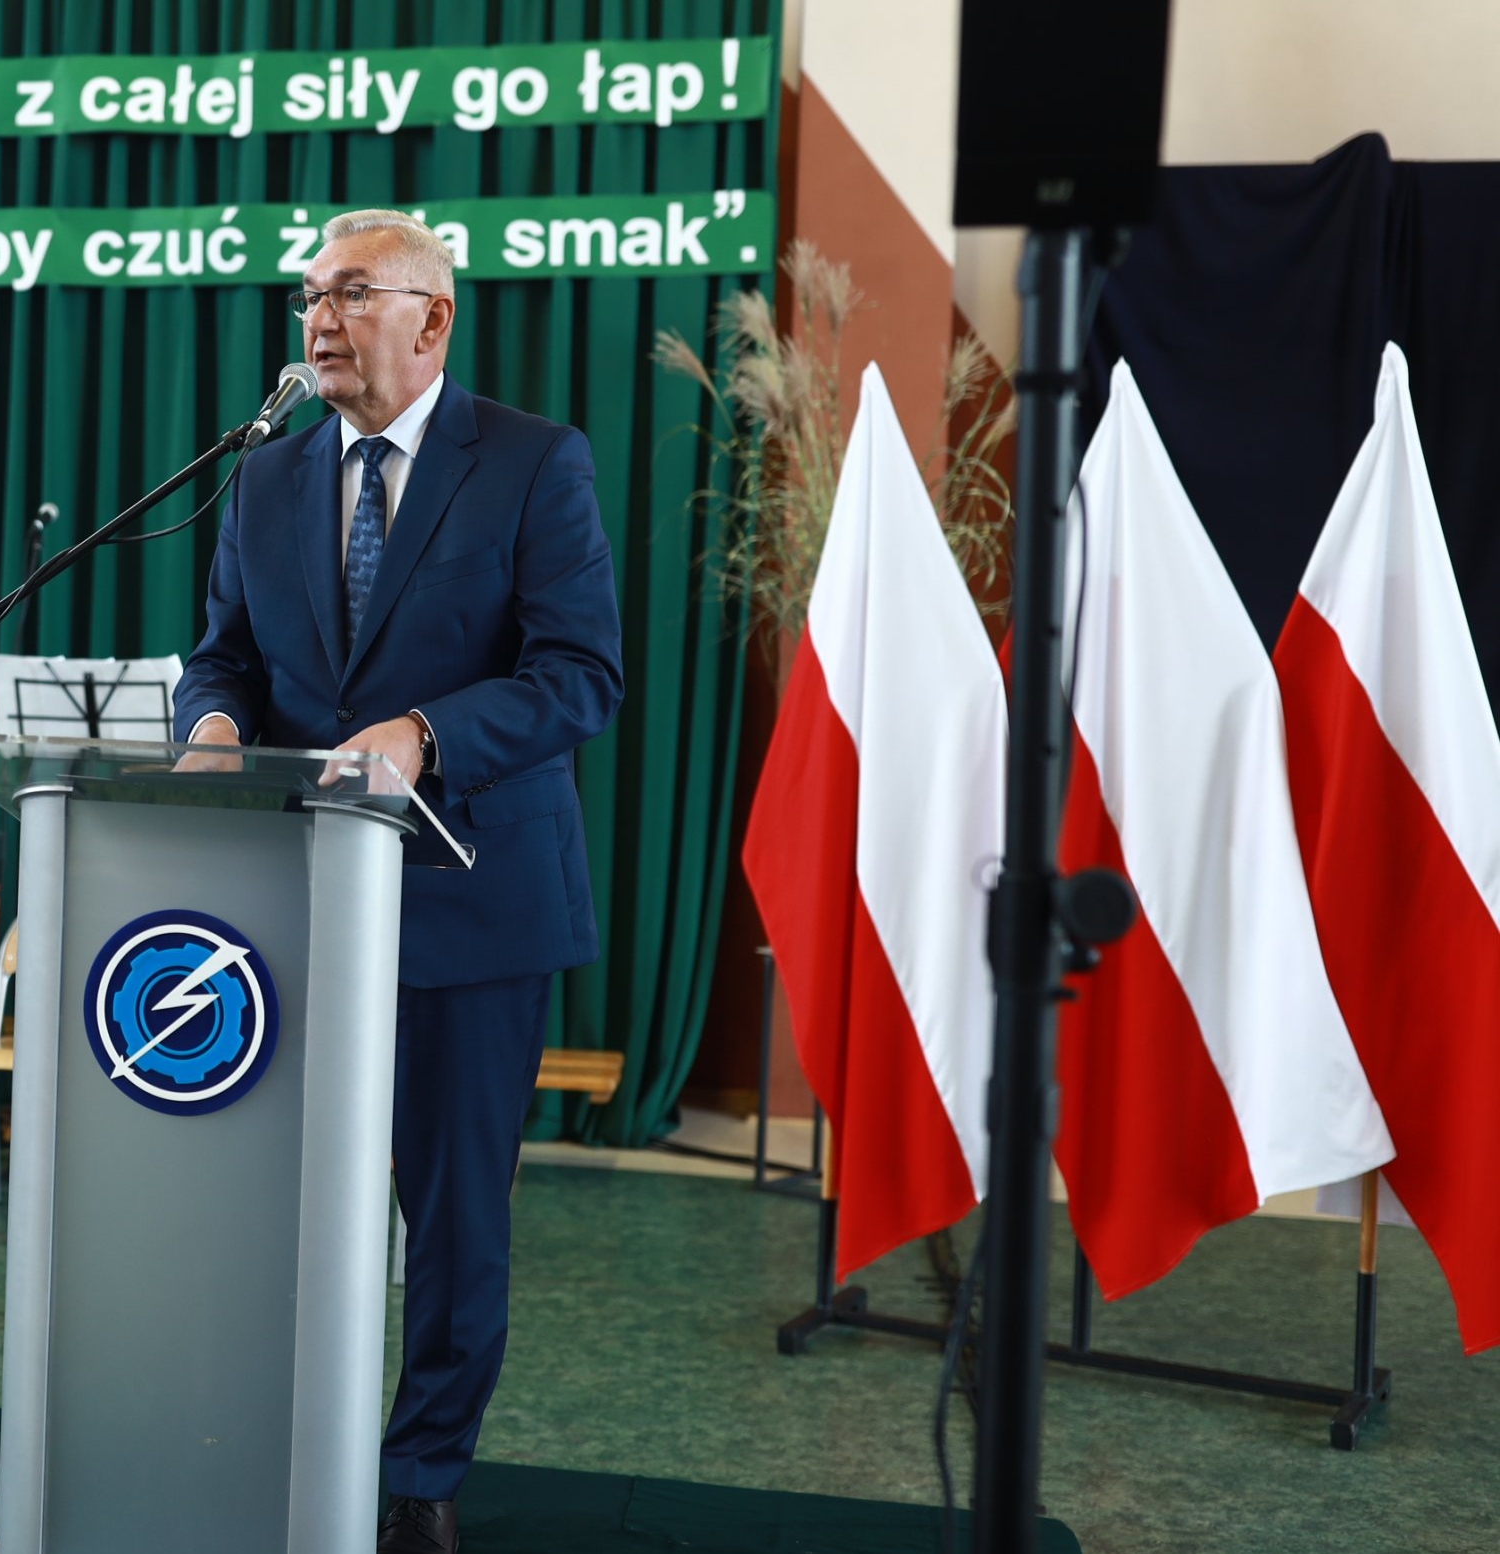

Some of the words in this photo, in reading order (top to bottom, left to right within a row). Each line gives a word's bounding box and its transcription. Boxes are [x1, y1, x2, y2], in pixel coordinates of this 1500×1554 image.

[14, 79, 55, 128] z
[79, 57, 255, 139] całej
[282, 56, 421, 135] siły
[451, 66, 550, 132] go
[82, 205, 248, 278] czuć
[501, 188, 758, 269] smak”.
